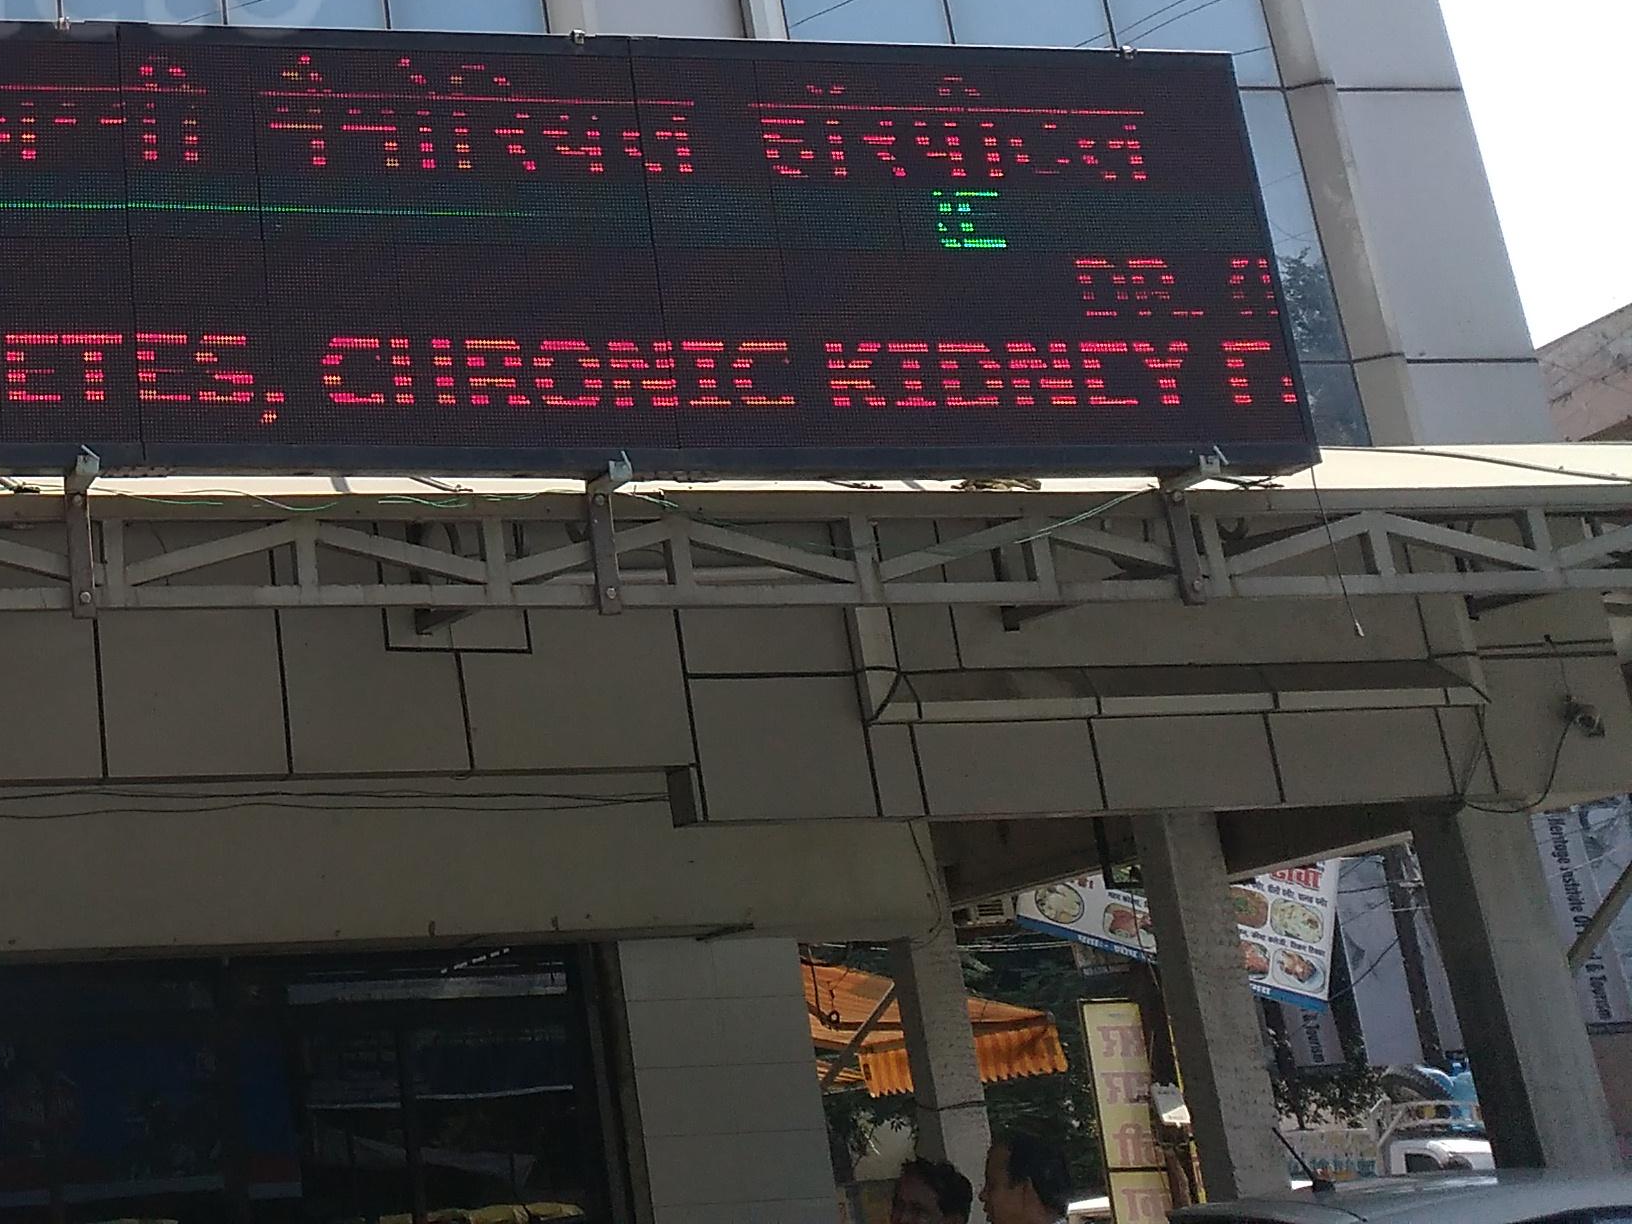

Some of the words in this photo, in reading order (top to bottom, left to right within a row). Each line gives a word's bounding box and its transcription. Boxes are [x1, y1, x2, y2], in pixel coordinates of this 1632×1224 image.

[321, 336, 797, 408] CHRONIC
[1548, 818, 1572, 864] Heritage
[1590, 975, 1614, 1021] Tourism
